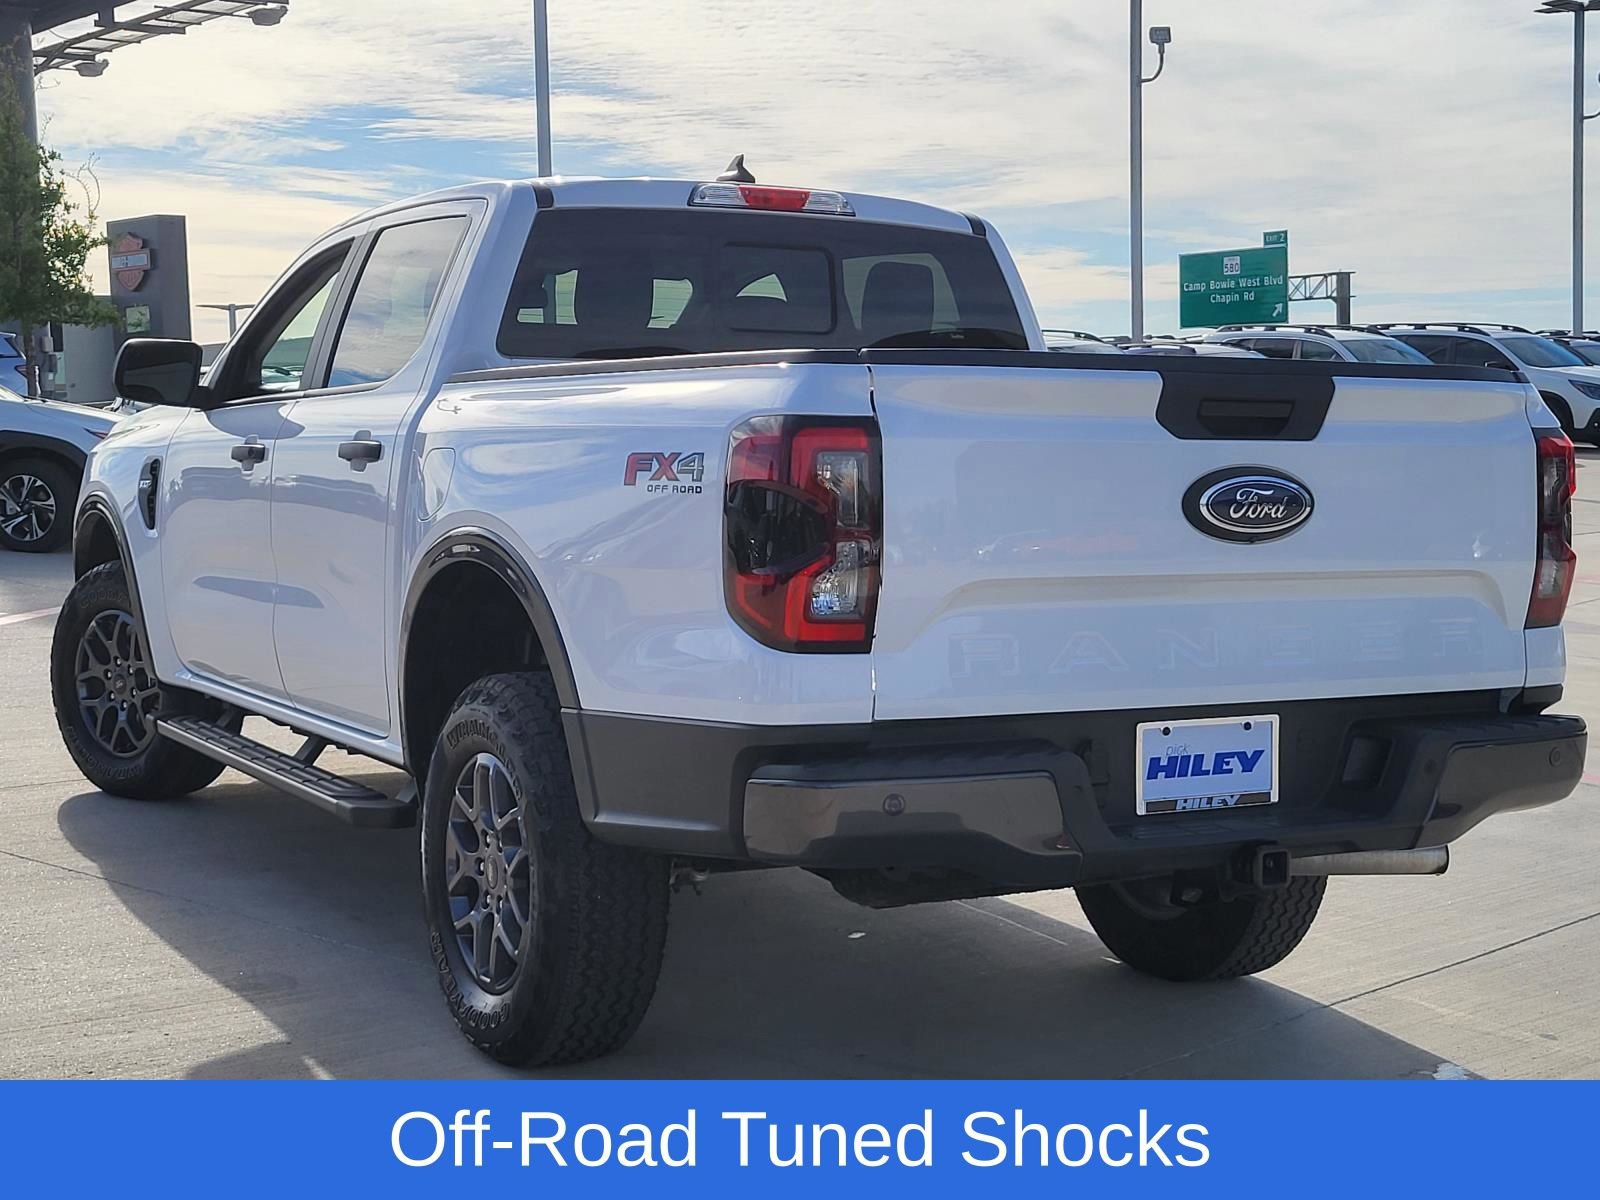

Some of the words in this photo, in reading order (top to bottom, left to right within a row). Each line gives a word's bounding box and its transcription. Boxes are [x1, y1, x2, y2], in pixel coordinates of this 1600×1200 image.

[1280, 233, 1285, 242] 2
[1224, 263, 1240, 273] 580
[1183, 281, 1207, 292] Camp
[1210, 279, 1235, 290] Bowie
[1239, 276, 1261, 288] West
[1264, 275, 1284, 286] Blvd
[1210, 292, 1240, 304] Chapin
[1244, 291, 1255, 301] Rd
[623, 452, 705, 486] FX4
[646, 484, 669, 493] OFF
[672, 485, 703, 494] ROAD
[1229, 487, 1289, 519] Ford
[948, 615, 1486, 679] RANGER
[1146, 749, 1265, 780] HILEY
[1176, 794, 1241, 811] HILEY
